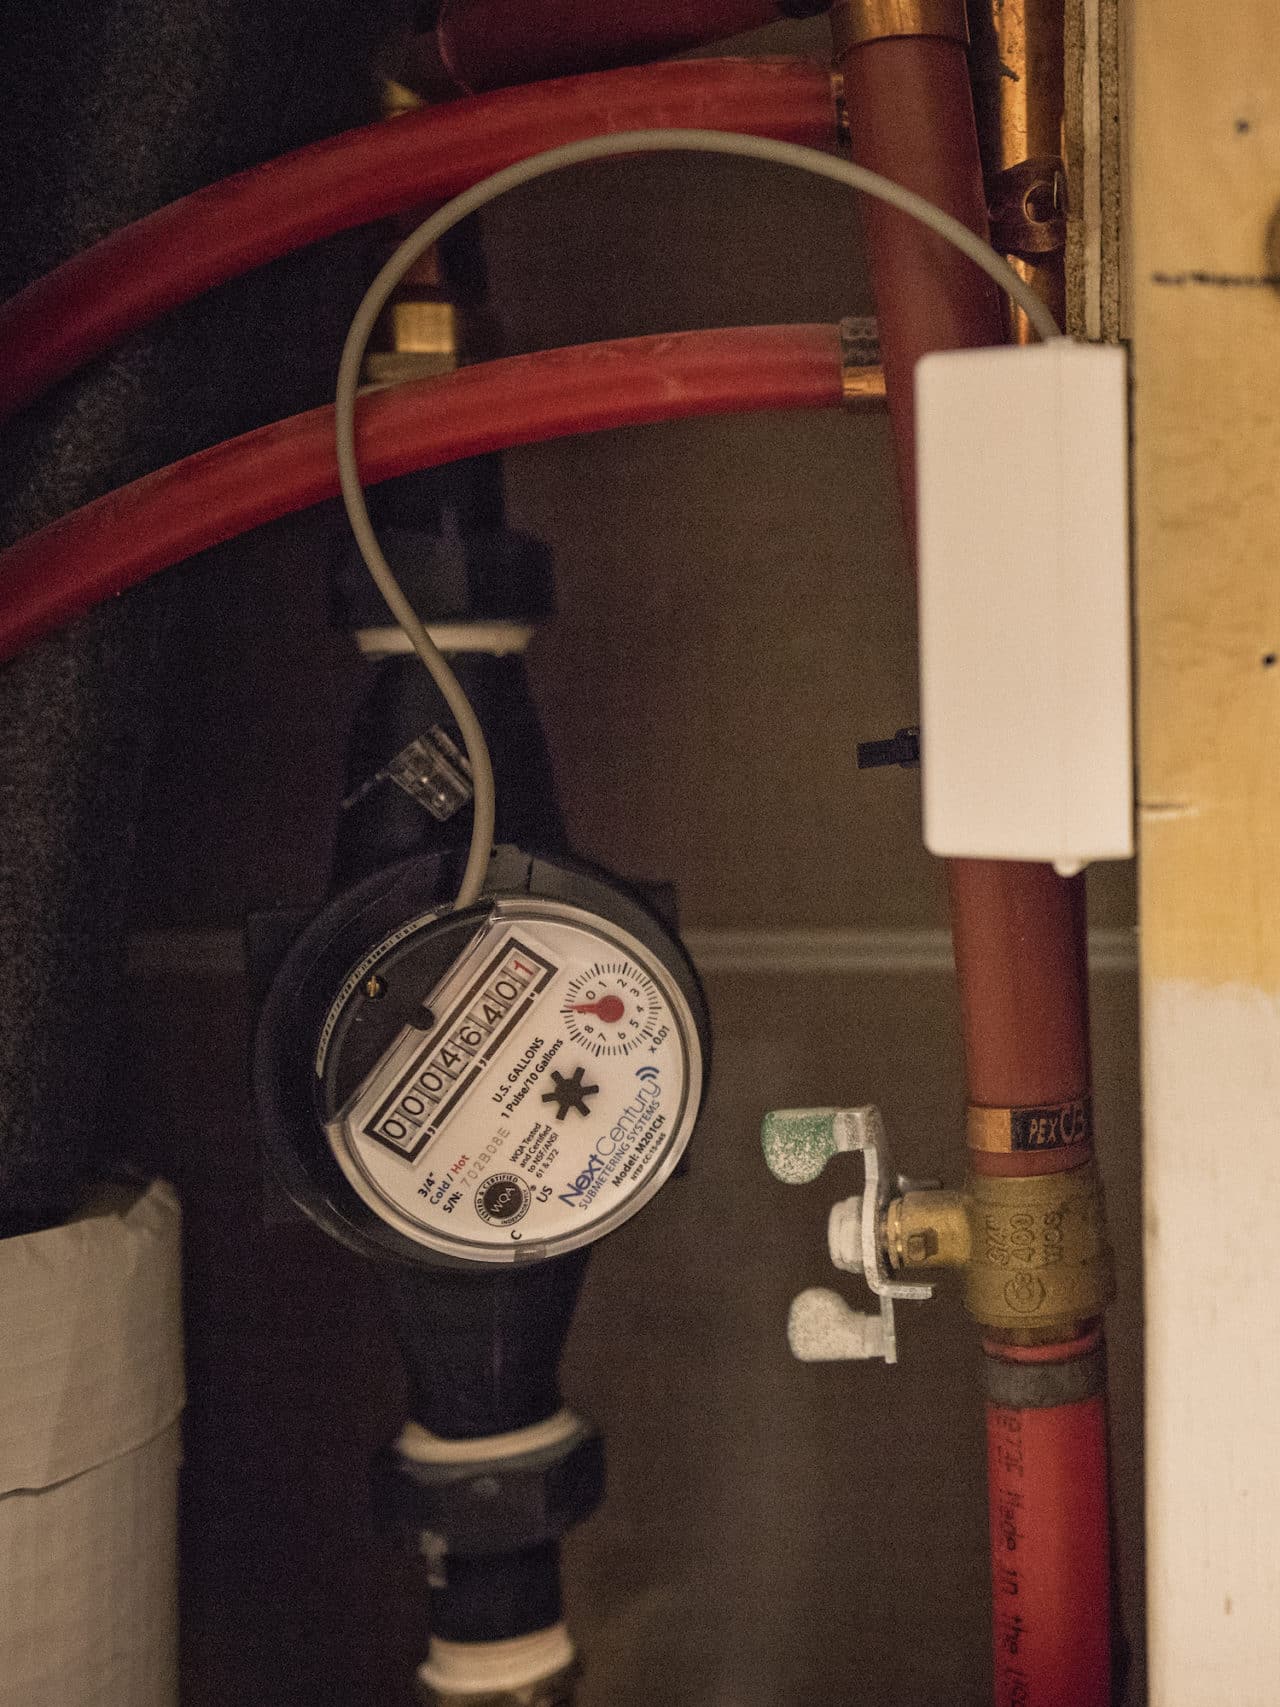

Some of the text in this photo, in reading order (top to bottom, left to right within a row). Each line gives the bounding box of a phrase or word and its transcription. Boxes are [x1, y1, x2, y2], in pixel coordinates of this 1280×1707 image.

[585, 990, 596, 1001] 0
[617, 979, 627, 988] 2
[630, 988, 640, 997] 3
[636, 1005, 644, 1013] 4
[584, 1025, 594, 1033] 8
[629, 1019, 639, 1028] 5
[652, 1025, 670, 1045] 0.01
[598, 1032, 606, 1041] 7
[617, 1032, 626, 1040] 6
[381, 958, 534, 1139] 00046401
[492, 1037, 544, 1103] U.S. GALLONS
[505, 1072, 538, 1112] Pulse/10
[535, 1039, 563, 1073] Gallons
[510, 1122, 541, 1162] WQA Tested
[1027, 1117, 1058, 1145] PEX
[520, 1125, 552, 1168] and Certified
[527, 1133, 558, 1173] to NSF/ANSI
[579, 1100, 660, 1209] SUBMETERING SYSTEMS
[612, 1115, 665, 1187] Model: M201CH
[536, 1149, 559, 1178] 61 & 372
[429, 1180, 451, 1205] Cold
[450, 1155, 469, 1174] Hot
[443, 1192, 463, 1213] S/N:
[491, 1184, 516, 1214] WQA
[536, 1186, 553, 1203] US
[510, 1230, 522, 1240] C
